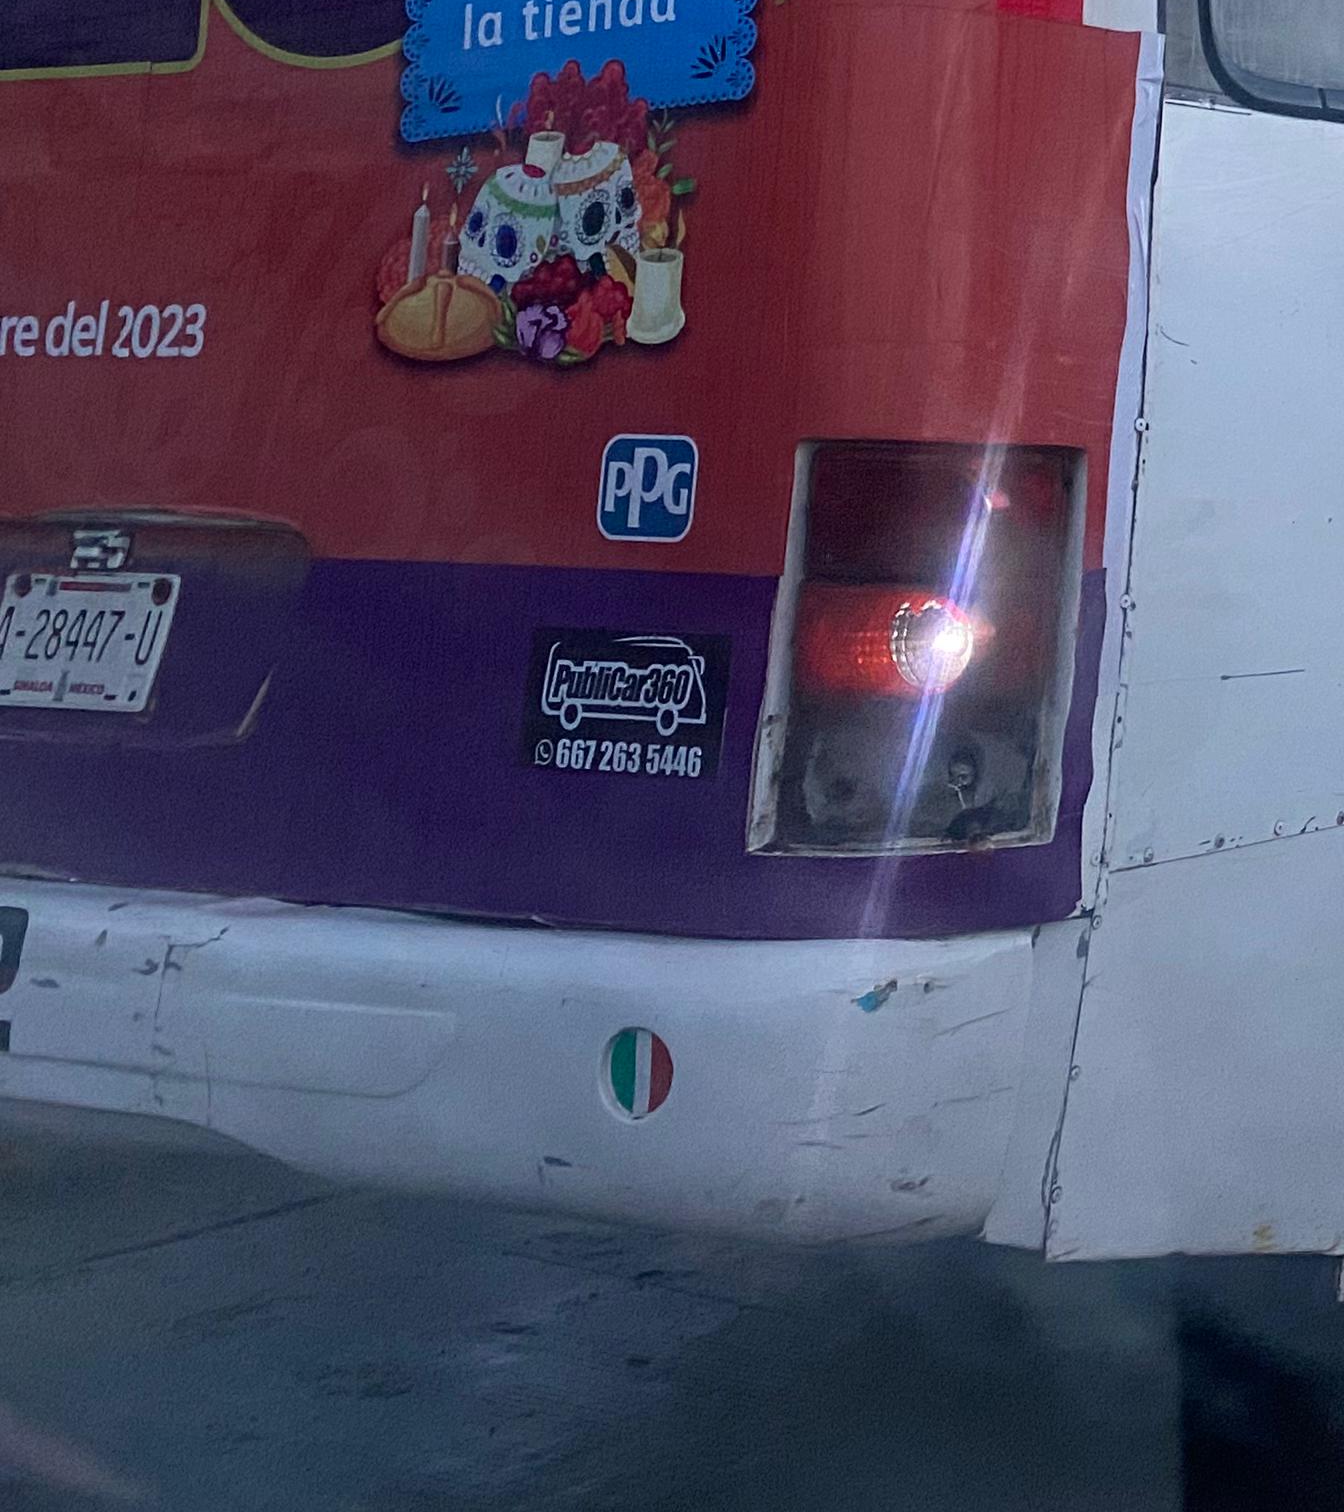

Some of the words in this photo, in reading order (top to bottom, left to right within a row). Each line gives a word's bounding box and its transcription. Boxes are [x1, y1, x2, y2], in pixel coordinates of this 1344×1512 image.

[462, 3, 503, 50] la
[45, 299, 110, 357] del
[111, 303, 207, 358] 2023
[550, 661, 693, 708] PubliCar360
[555, 738, 597, 770] 667
[599, 741, 641, 774] 263
[646, 743, 702, 778] 5446
